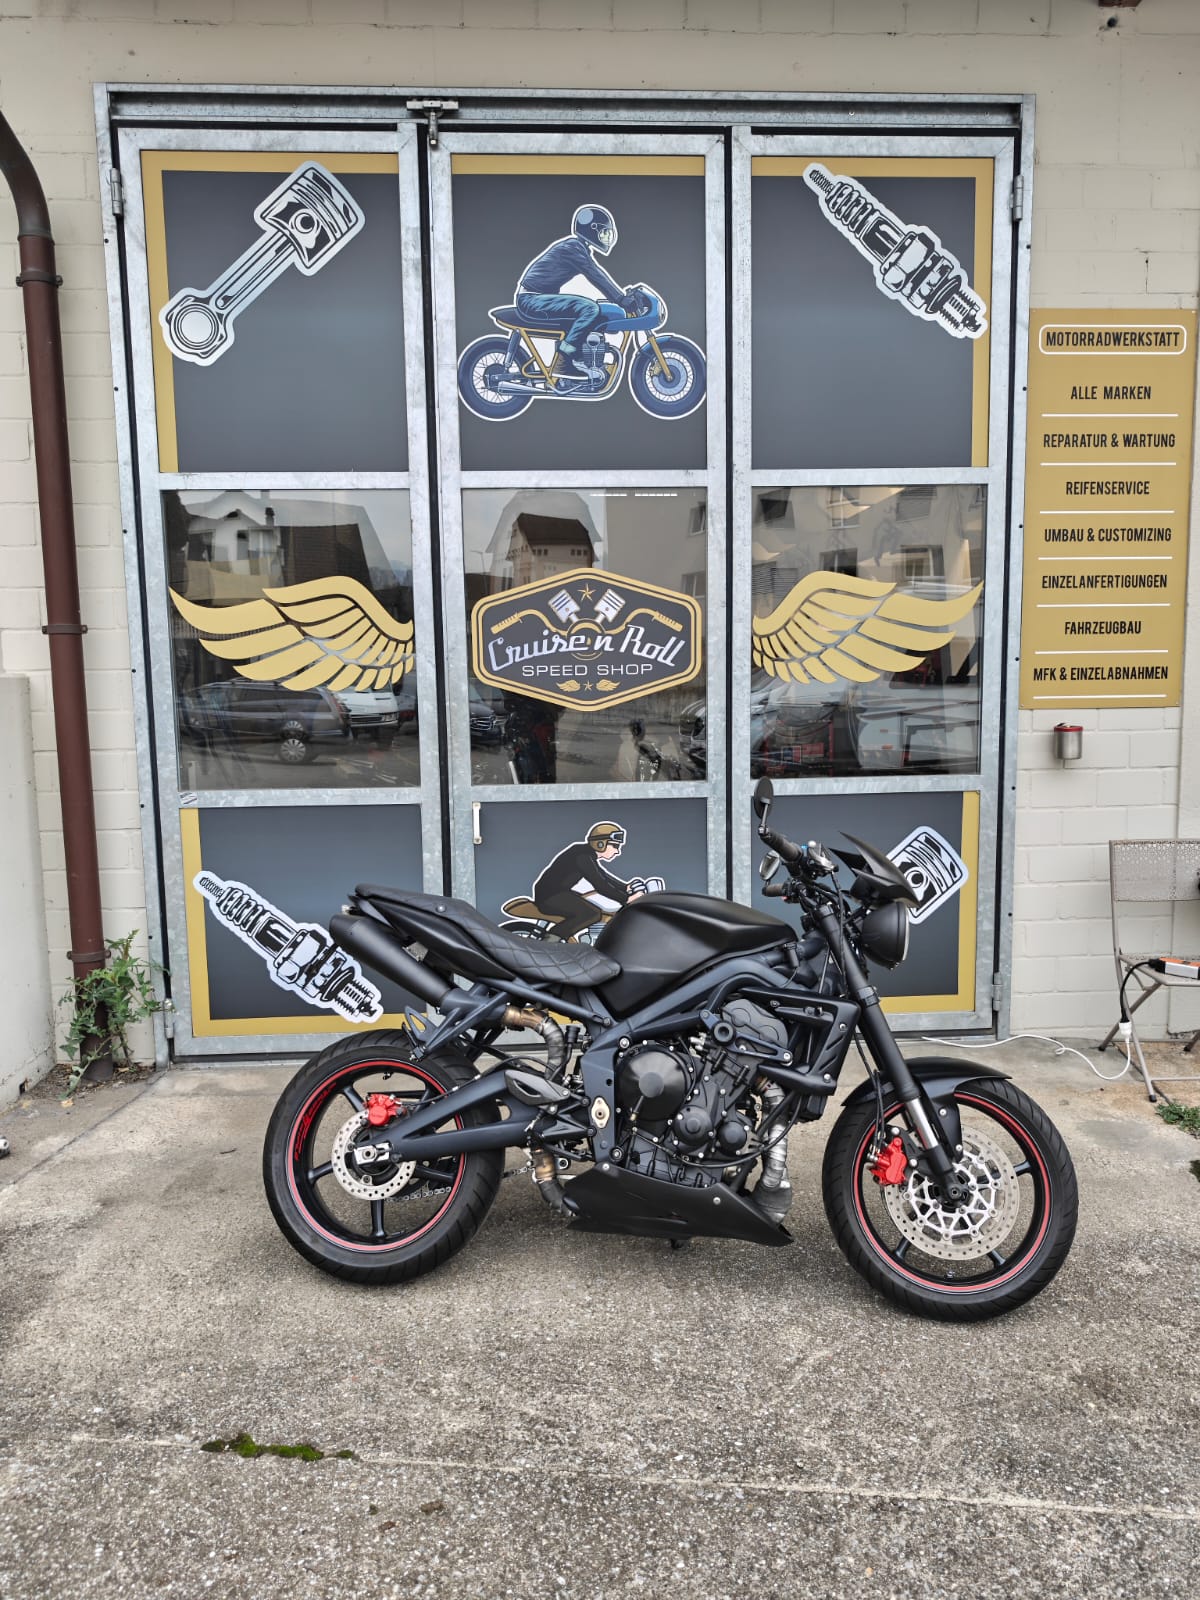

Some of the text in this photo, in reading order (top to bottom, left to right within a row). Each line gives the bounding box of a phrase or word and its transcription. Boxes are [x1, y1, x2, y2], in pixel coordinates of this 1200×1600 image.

[1046, 331, 1180, 347] MOTORRADWERKSTATT
[1070, 386, 1152, 400] ALLE MARKEN
[1043, 433, 1176, 448] REPARATUR & WARTUNG
[1066, 481, 1150, 495] REIFENSERVICE
[1044, 528, 1172, 542] UMBAU & CUSTOMIZING
[1042, 575, 1167, 589] EINZELANFERTIGUNGEN
[1065, 621, 1142, 635] FAHRZEUGBAU
[488, 624, 686, 671] Cruise n Roll
[521, 663, 653, 677] SPEED SHOP
[1033, 666, 1168, 681] MFK & EINZELABNAHMEN
